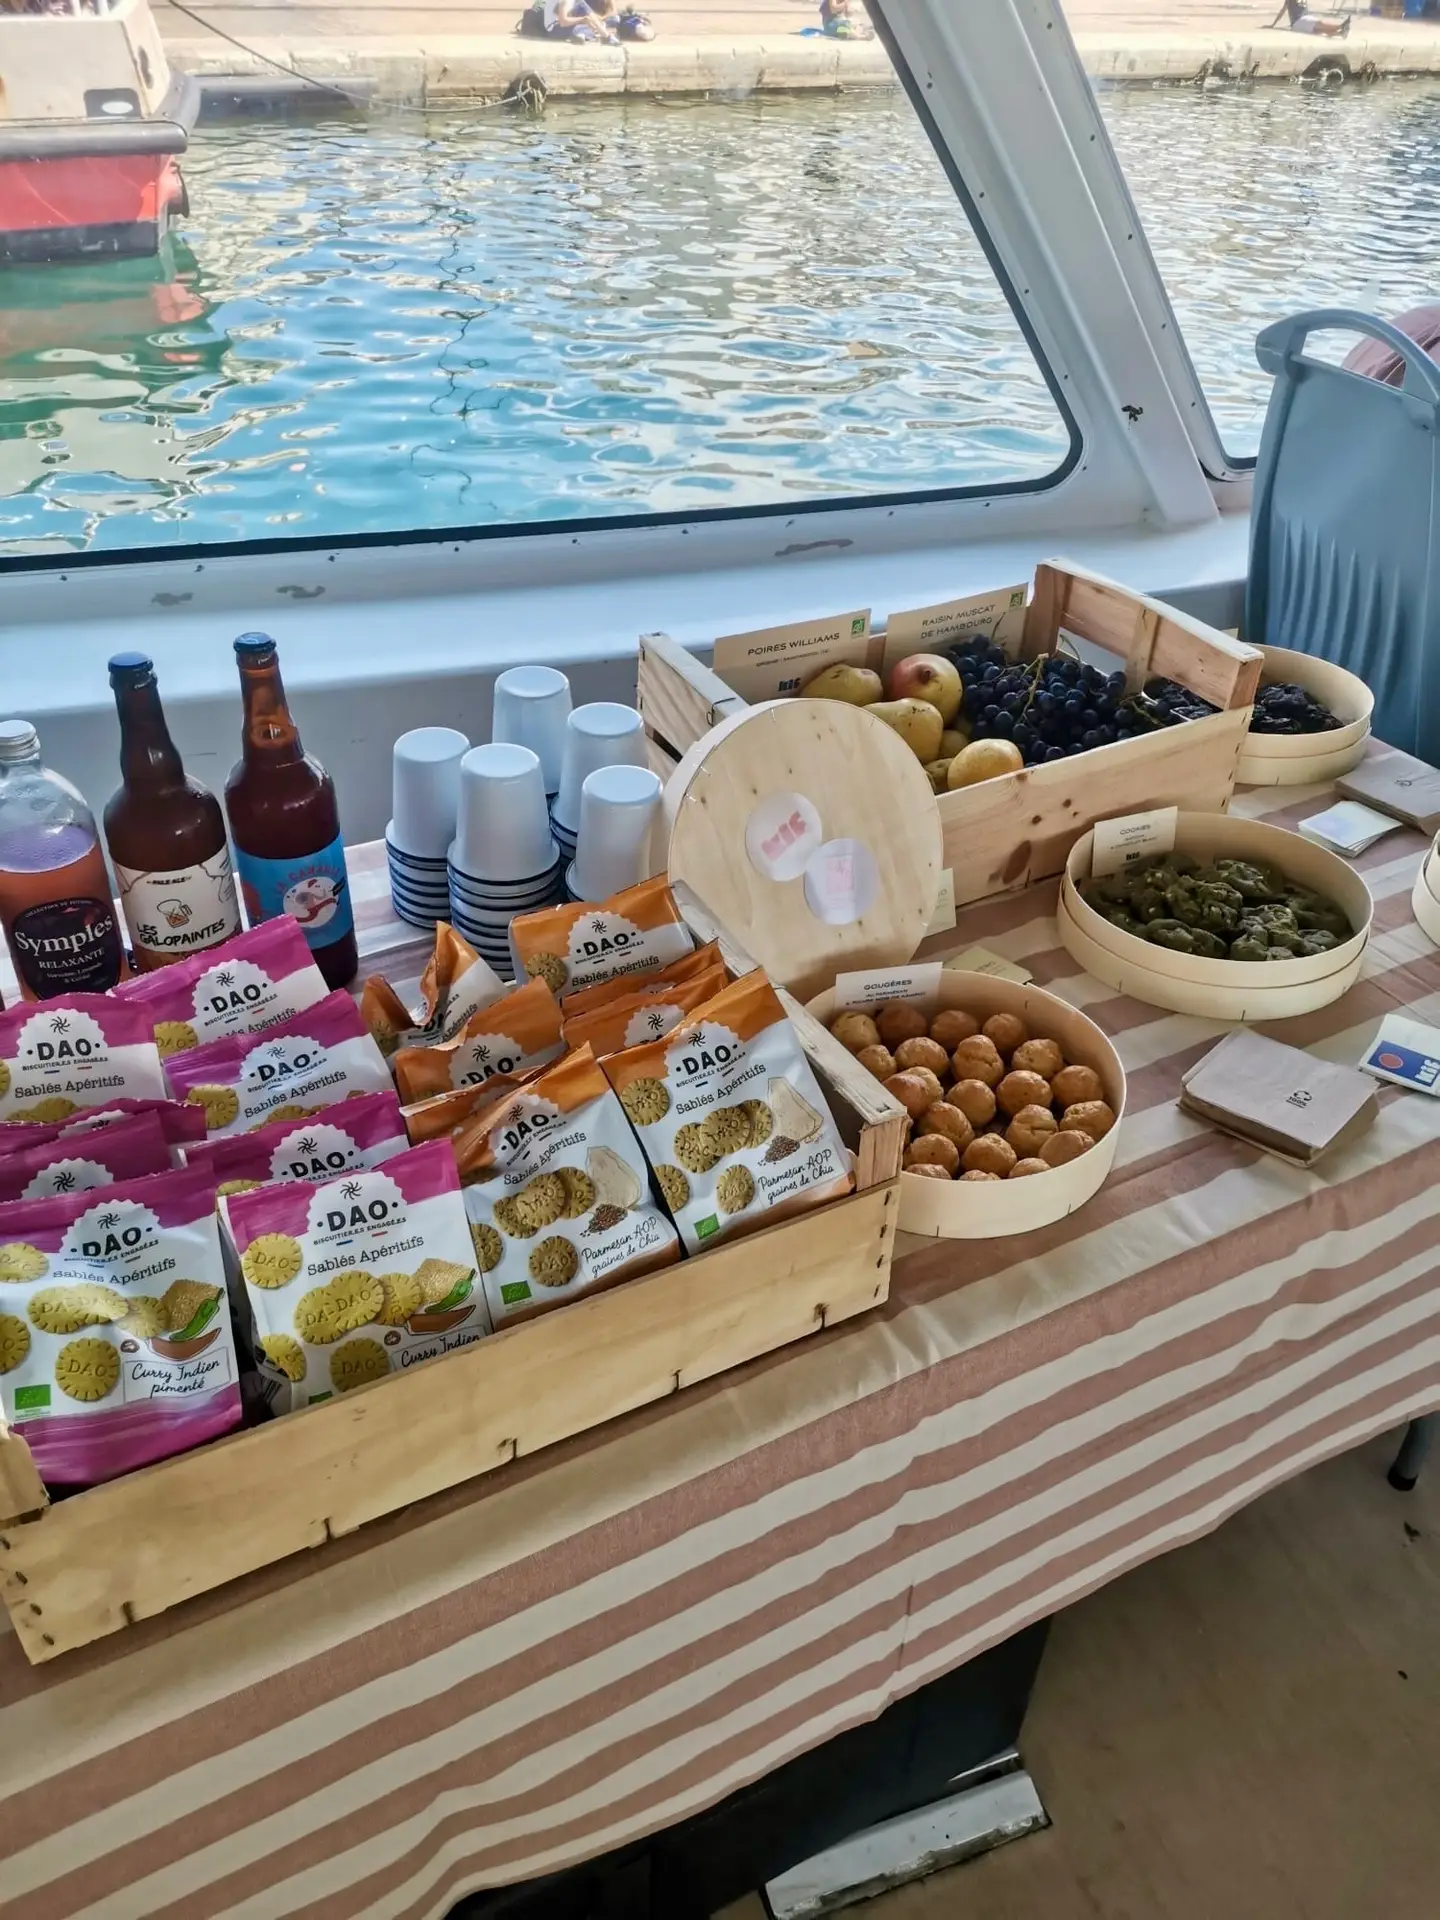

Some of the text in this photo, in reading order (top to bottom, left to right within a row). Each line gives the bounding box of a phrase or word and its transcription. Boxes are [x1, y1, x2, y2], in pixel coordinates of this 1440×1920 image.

[921, 630, 934, 639] DE
[936, 616, 993, 636] HAMBOURG
[922, 604, 996, 626] RAISIN MUSCAT
[747, 642, 787, 656] POIRES
[789, 632, 840, 649] WILLIAMS
[14, 915, 113, 957] Symples
[136, 921, 158, 935] LES
[583, 933, 629, 956] DAO
[572, 956, 660, 987] Sablés Apéritifs
[211, 984, 261, 1013] DAO
[36, 1038, 92, 1061] DAO
[682, 1045, 731, 1075] DAO
[257, 1054, 311, 1081] DAO
[15, 1075, 125, 1099] Sablés Apéritifs
[244, 1070, 347, 1118] Sablés Apéritifs
[676, 1064, 767, 1114] Sablés Apéritifs
[504, 1114, 549, 1150] DAO
[289, 1151, 346, 1178] DAO
[504, 1132, 587, 1185] Sablés Apéritifs
[758, 1149, 832, 1192] Parmesan AOP
[768, 1165, 834, 1206] graines de Chia
[327, 1199, 388, 1232] DAO
[82, 1227, 142, 1257] DAO
[582, 1216, 658, 1264] Parmesan AOP
[308, 1236, 425, 1276] Sablés Apéritifs
[592, 1233, 660, 1278] graines de Chia
[53, 1258, 176, 1285] Sablés Apéritifs
[439, 1333, 480, 1354] Indien
[68, 1359, 108, 1378] DAO
[131, 1360, 220, 1386] Curry Indien
[150, 1378, 205, 1400] pimenté
